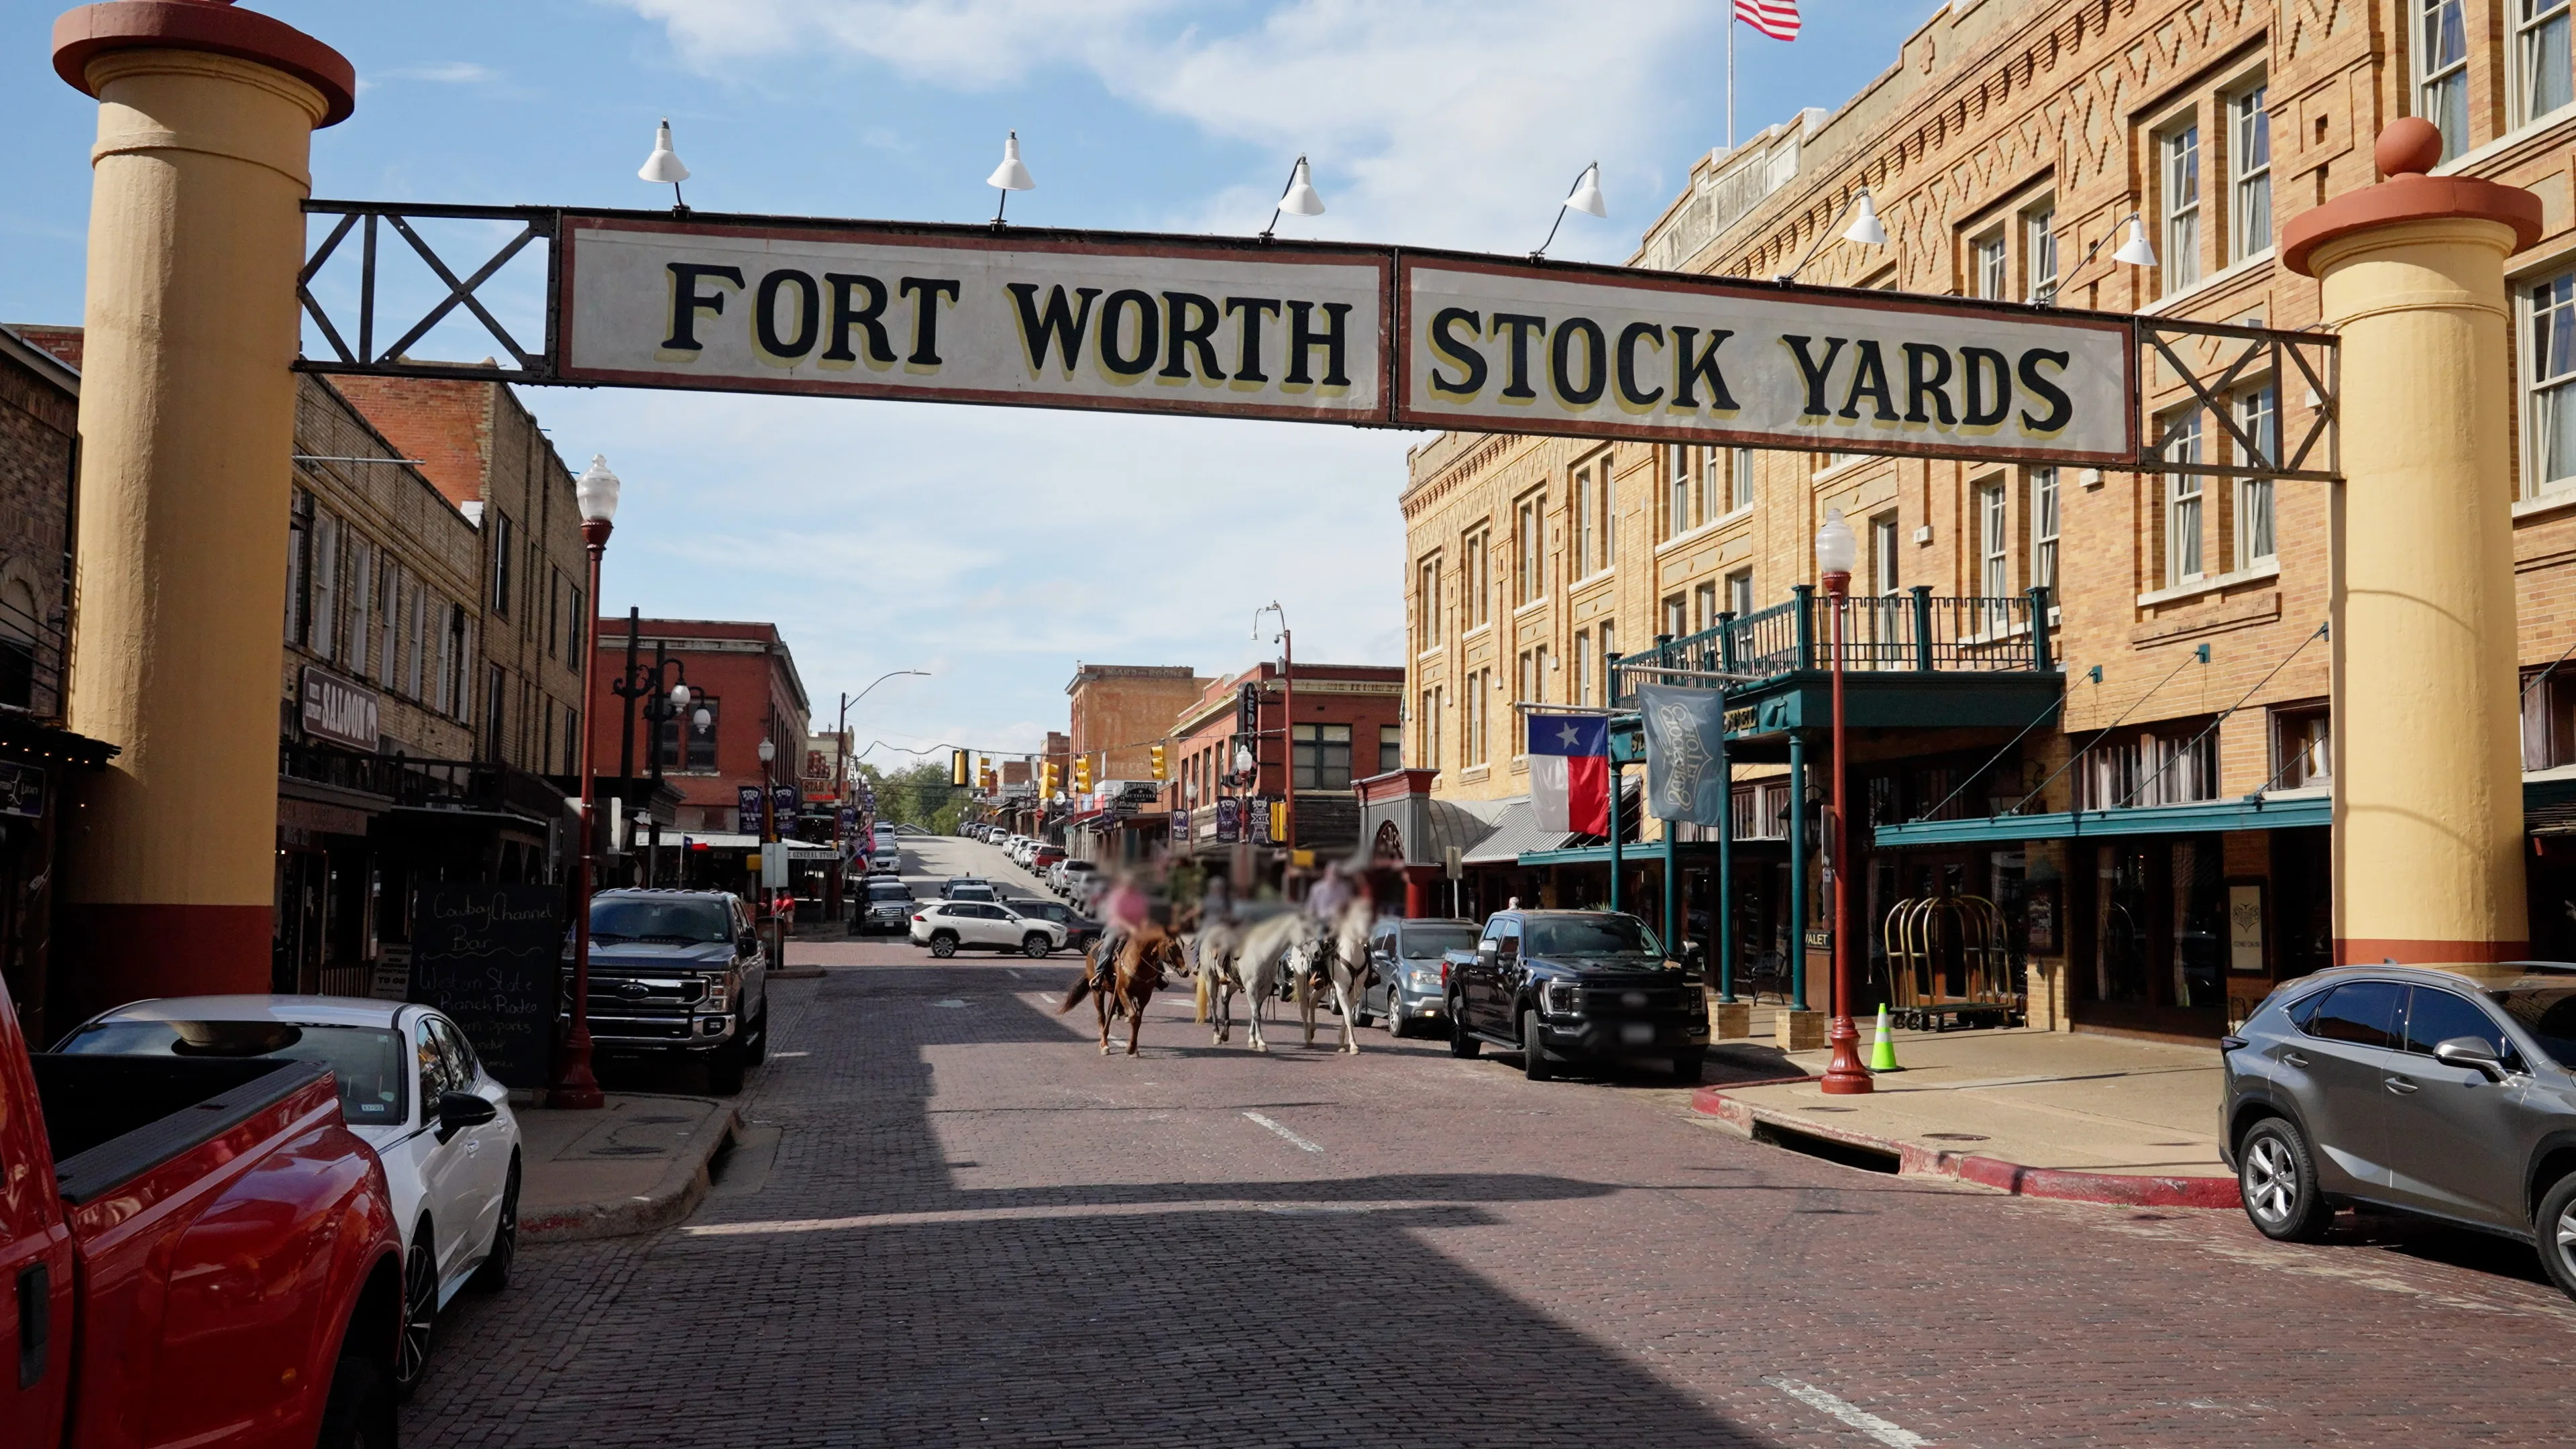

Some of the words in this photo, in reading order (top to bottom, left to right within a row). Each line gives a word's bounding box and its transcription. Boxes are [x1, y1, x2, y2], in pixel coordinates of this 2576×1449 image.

[653, 262, 960, 375] FORT
[1004, 283, 1352, 396] WORTH
[1426, 308, 1741, 420] STOCK
[1778, 334, 2072, 440] YARDS
[322, 682, 366, 741] SALOON
[1723, 706, 1756, 734] OTEL
[742, 790, 759, 798] TCU
[775, 789, 792, 798] TCU
[804, 781, 824, 792] STAR
[826, 781, 848, 792] CE
[1220, 800, 1236, 808] TCU
[1252, 800, 1268, 808] TCU
[434, 892, 490, 932] Cowboy
[491, 892, 553, 920] Channel
[447, 924, 492, 951] Bar
[419, 965, 482, 991] Western
[433, 990, 491, 1012] Ranch
[492, 994, 537, 1015] Rodeo
